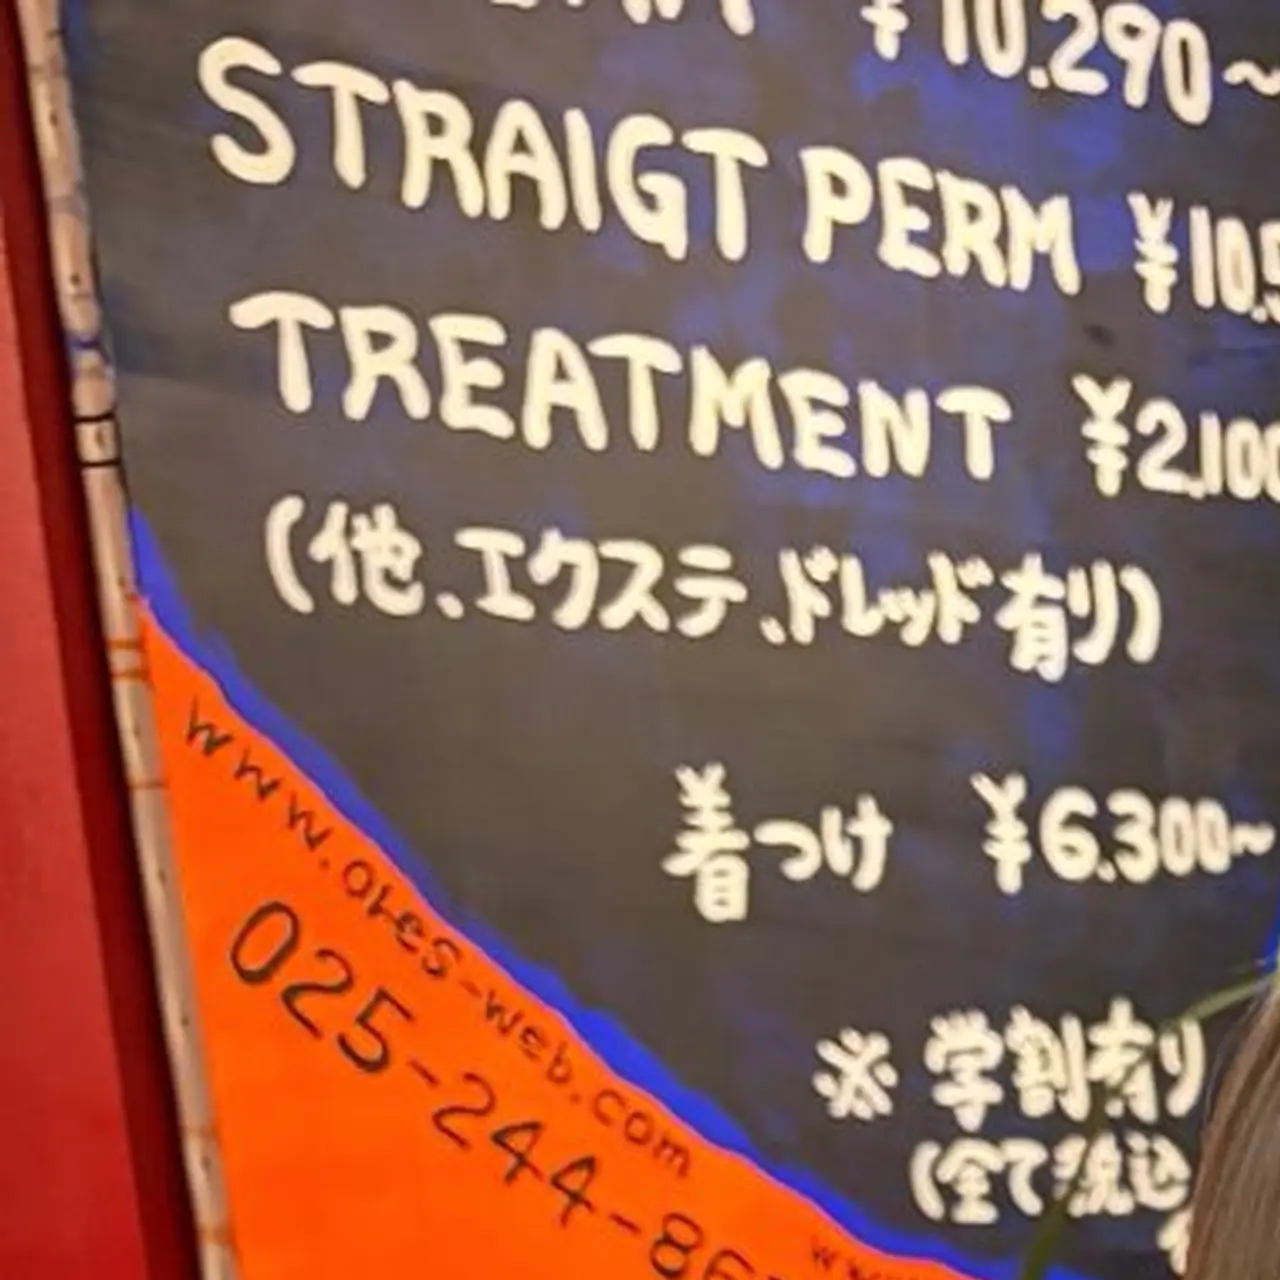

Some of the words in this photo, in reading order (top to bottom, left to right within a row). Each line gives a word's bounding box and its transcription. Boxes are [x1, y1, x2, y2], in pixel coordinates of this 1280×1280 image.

[198, 36, 770, 262] STRAIGT
[800, 146, 1081, 295] PERM
[228, 290, 1012, 482] TREATMENT
[660, 761, 894, 924] 着つけ
